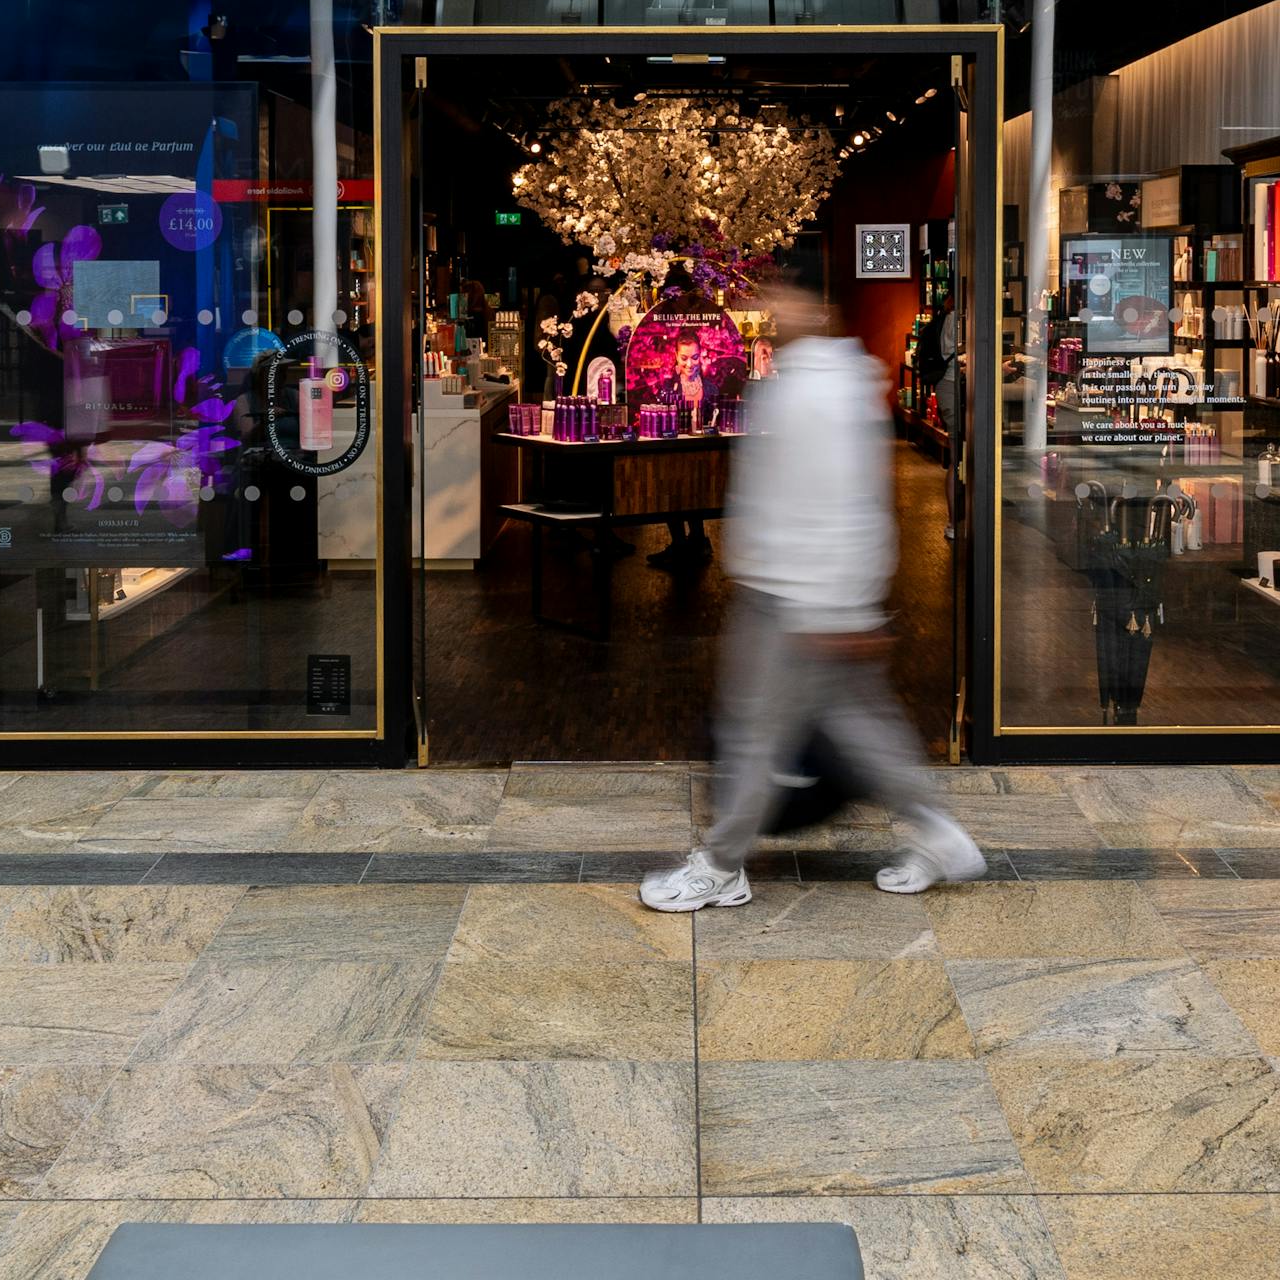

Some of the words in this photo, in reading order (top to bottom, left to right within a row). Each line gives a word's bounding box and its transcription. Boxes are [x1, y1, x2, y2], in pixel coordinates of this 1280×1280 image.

[151, 142, 193, 153] Parfum
[1111, 248, 1147, 260] NEW
[653, 313, 685, 321] BELIEVE
[686, 313, 700, 321] THE
[702, 313, 721, 321] HYPE
[290, 333, 330, 346] TRENDING
[331, 336, 343, 346] ON
[1082, 358, 1124, 367] Happiness
[268, 359, 280, 400] TRENDING
[277, 347, 287, 359] ON
[346, 346, 366, 384] TRENDING
[360, 385, 366, 399] ON
[1082, 371, 1090, 379] in
[1092, 371, 1107, 379] the
[1116, 384, 1147, 393] passion
[268, 408, 275, 421] ON
[355, 407, 366, 450] TRENDING
[1115, 421, 1138, 429] about
[1139, 422, 1155, 431] you
[269, 423, 289, 461] TRENDING
[1113, 434, 1137, 442] about
[1154, 434, 1183, 443] planet.
[347, 448, 358, 460] ON
[292, 461, 304, 471] ON
[305, 460, 344, 474] TRENDING
